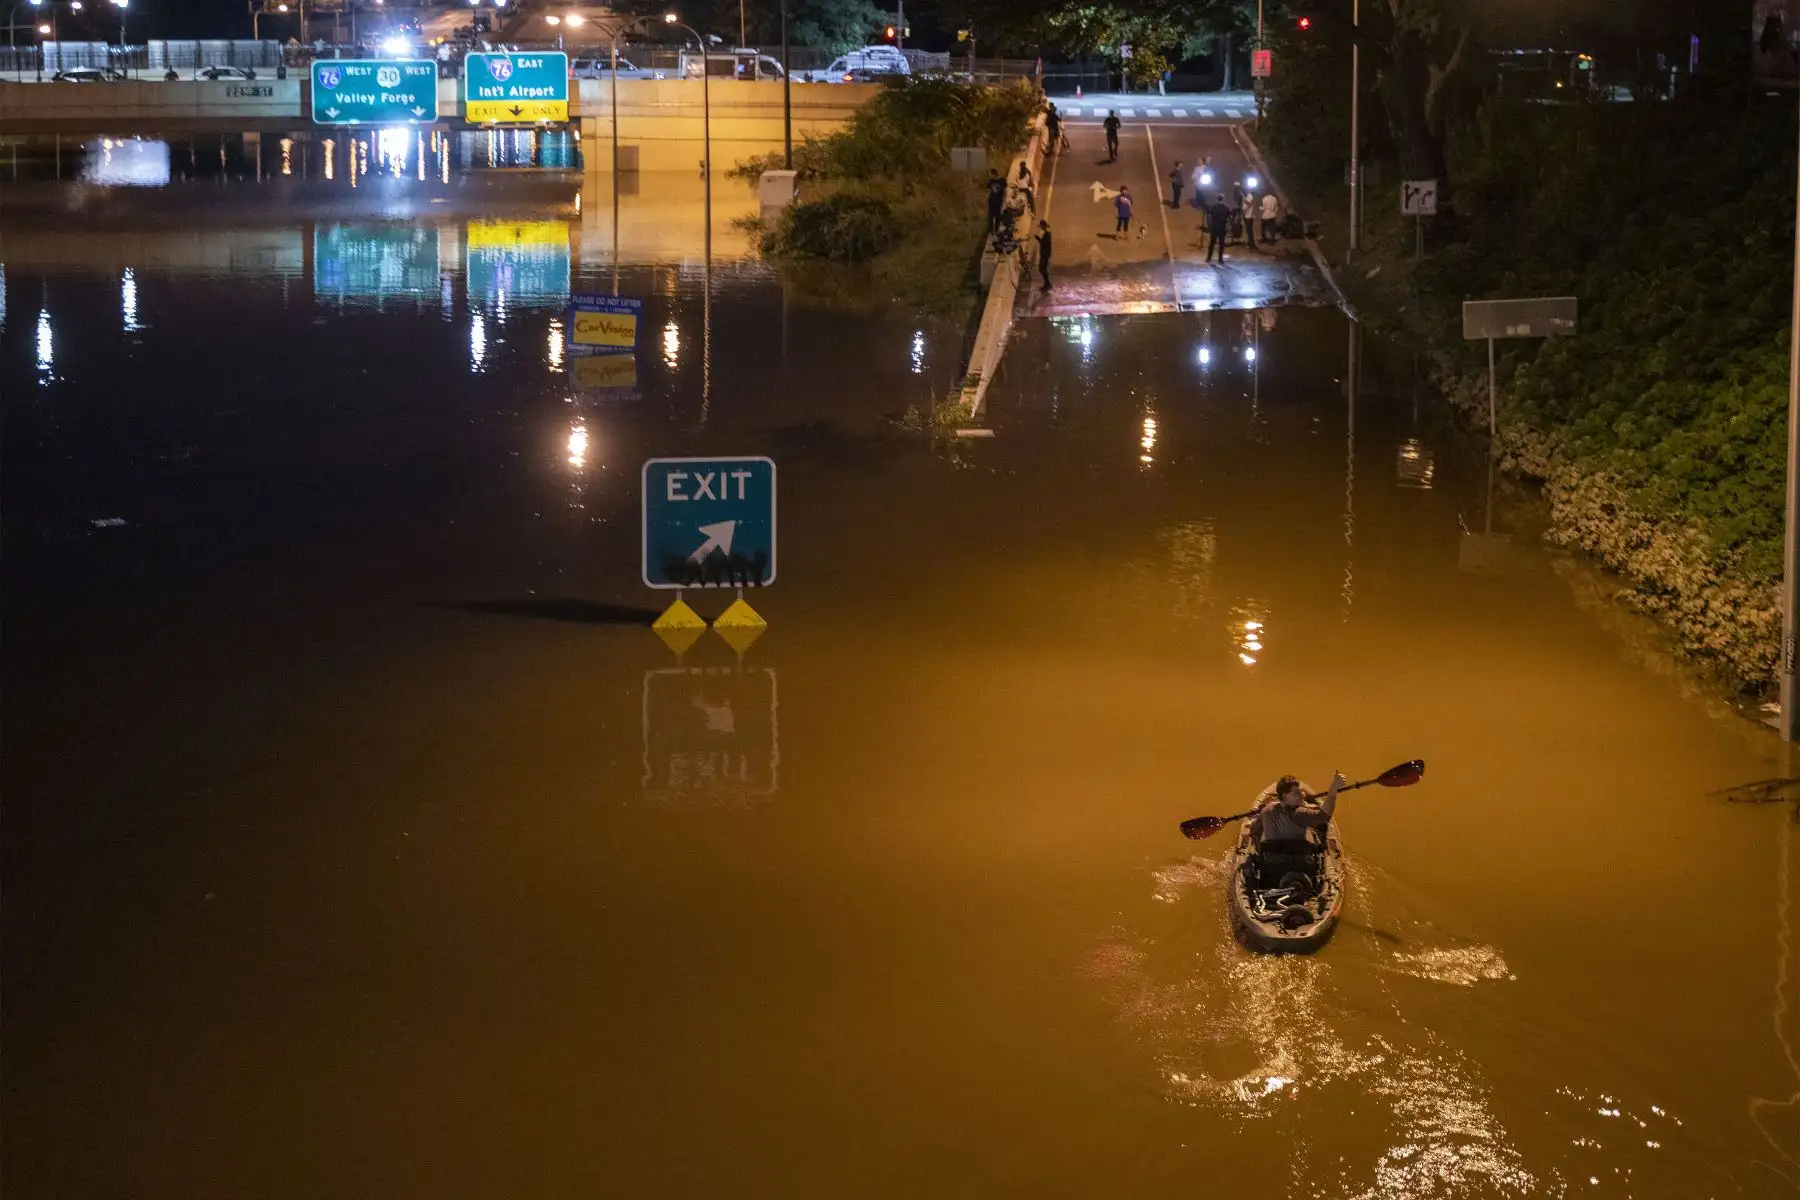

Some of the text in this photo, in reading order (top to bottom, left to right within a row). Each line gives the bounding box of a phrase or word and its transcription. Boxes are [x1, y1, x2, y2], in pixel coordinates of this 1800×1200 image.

[493, 58, 544, 77] 76 EAST
[321, 66, 432, 85] 76 WEST 30 WEST
[479, 85, 555, 98] Int'l Airport
[335, 92, 416, 106] Valley Forge
[474, 106, 560, 116] EXIT ONLY
[572, 295, 641, 308] PLEASE DO NOT LITTER
[666, 471, 752, 501] EXIT
